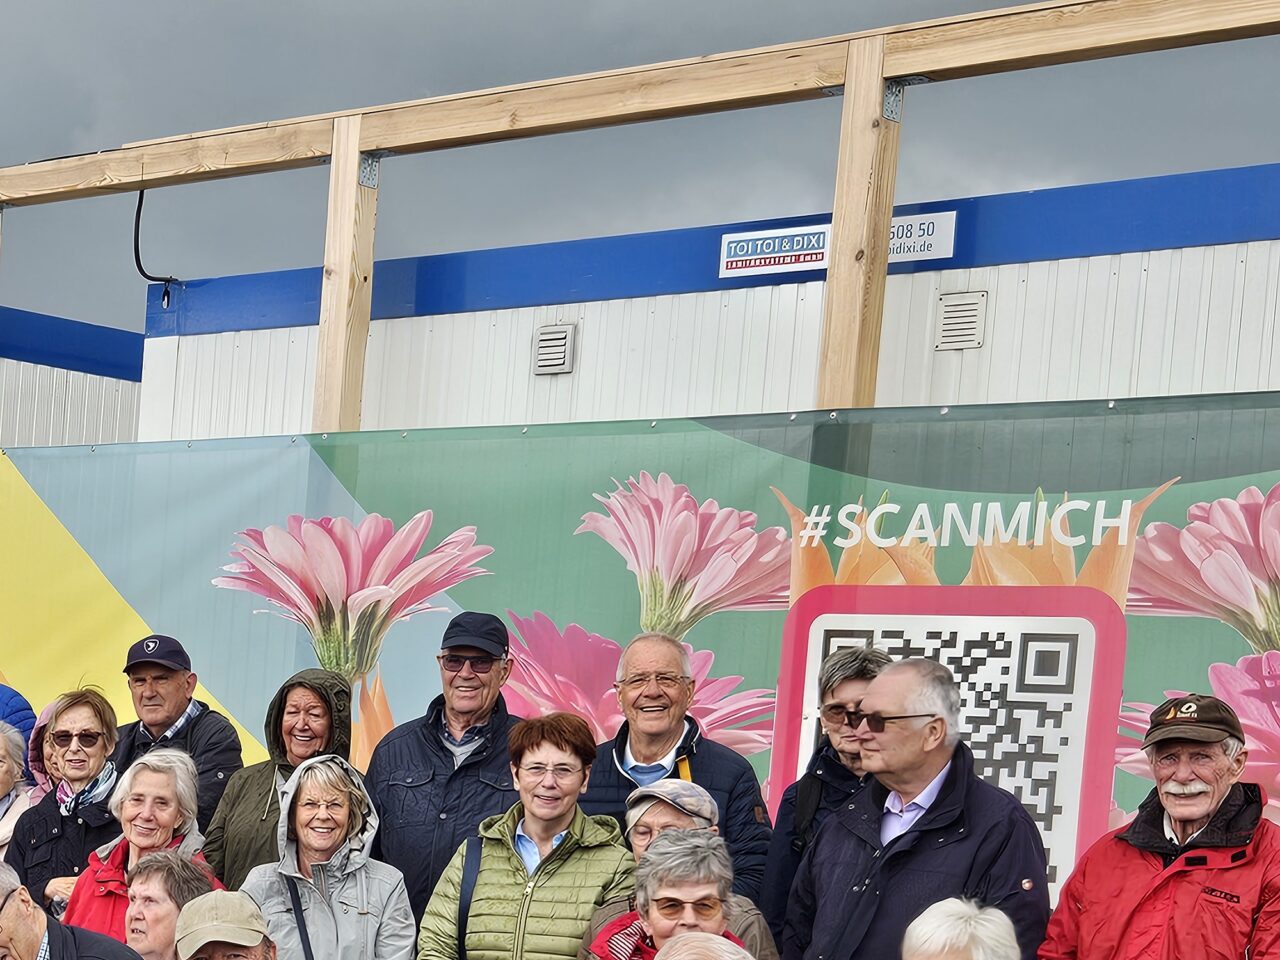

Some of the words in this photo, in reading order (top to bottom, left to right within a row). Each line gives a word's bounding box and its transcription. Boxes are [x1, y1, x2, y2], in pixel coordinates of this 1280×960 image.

[918, 221, 935, 238] 50
[729, 240, 752, 256] TOI
[756, 237, 779, 253] TOI
[781, 238, 791, 250] &
[793, 233, 824, 250] DIXI
[798, 499, 1133, 549] #SCANMICH
